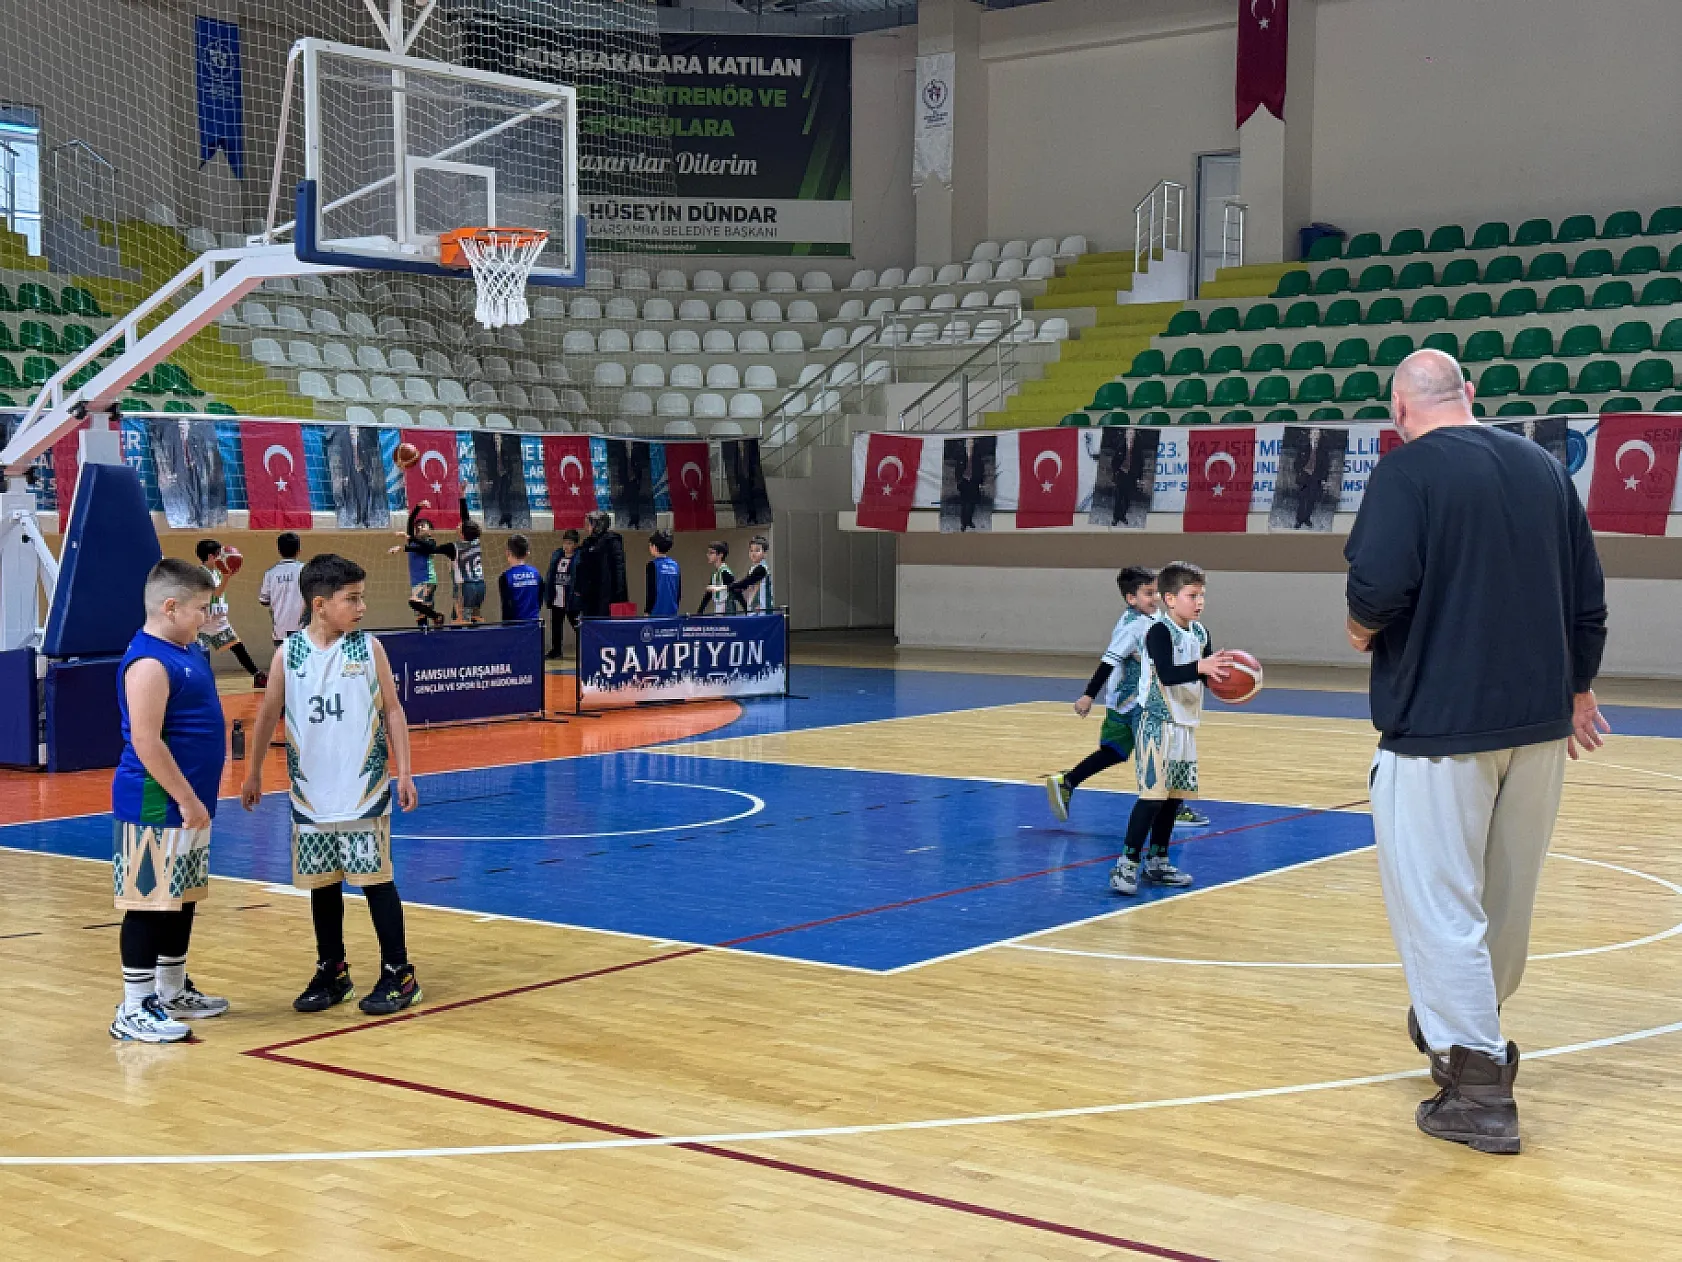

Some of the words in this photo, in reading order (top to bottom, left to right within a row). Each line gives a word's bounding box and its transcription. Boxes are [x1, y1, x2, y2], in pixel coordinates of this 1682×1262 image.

[707, 56, 802, 76] KATILAN
[759, 90, 788, 108] VE
[675, 151, 757, 176] Dilerim
[589, 200, 682, 220] HÜSEYİN
[688, 202, 778, 223] DÜNDAR
[662, 225, 721, 237] BELEDİYE
[724, 227, 778, 239] BAŞKANI
[600, 640, 765, 679] ŞAMPİYON
[414, 667, 457, 681] SAMSUN
[459, 663, 513, 680] ÇARŞAMBA
[308, 693, 345, 724] 34
